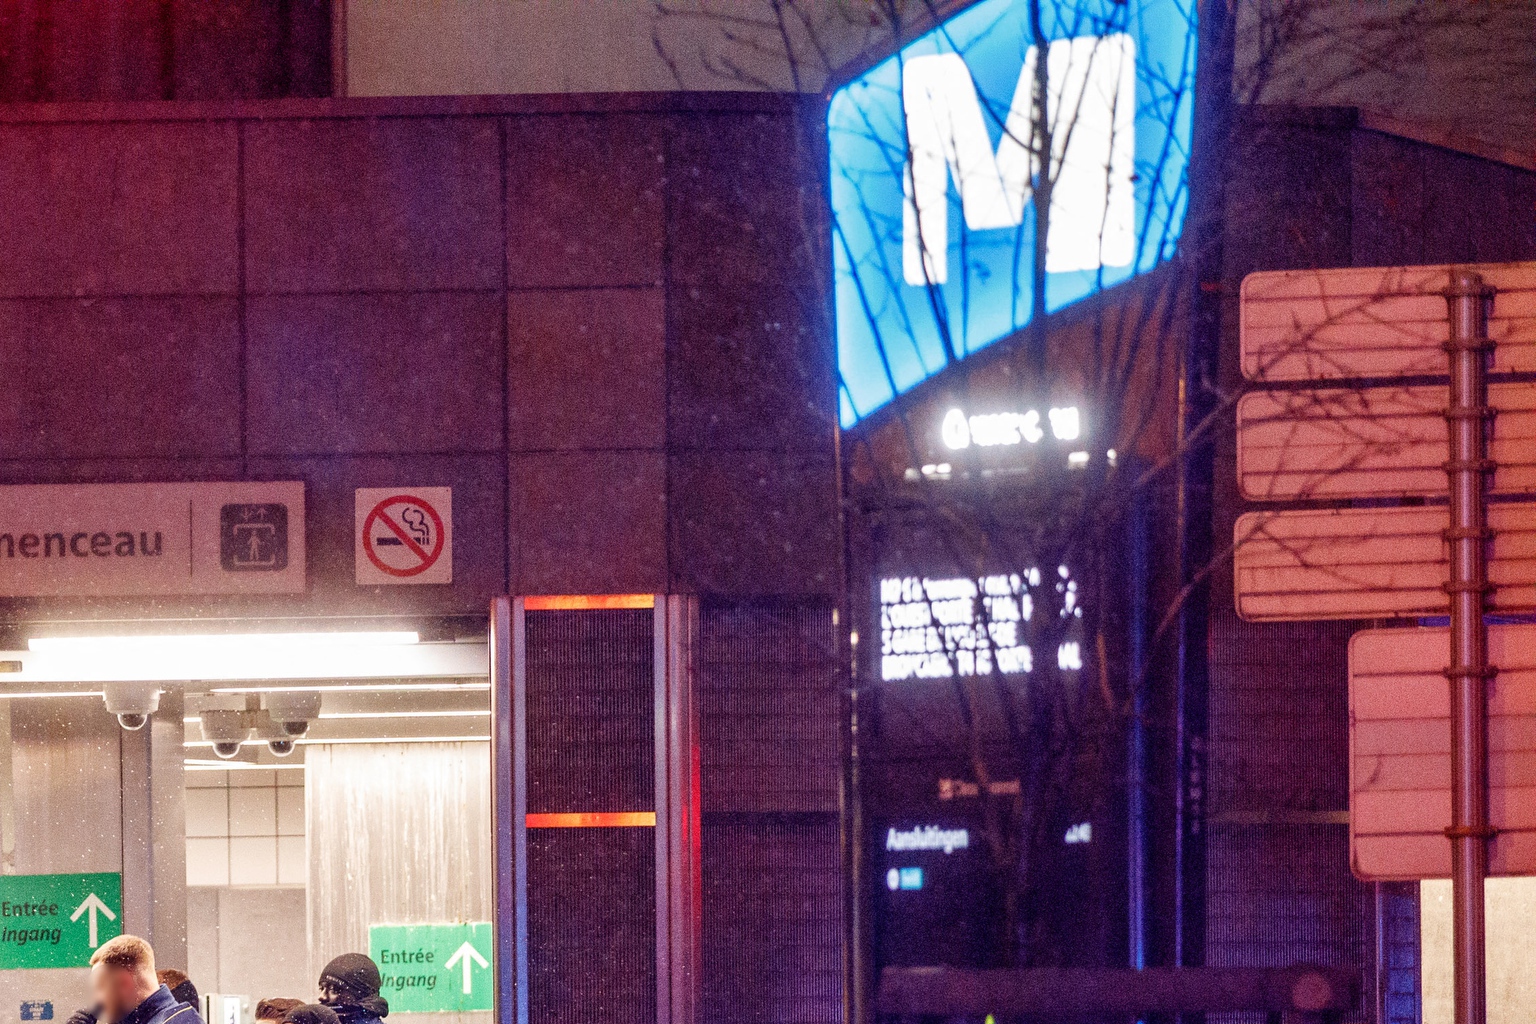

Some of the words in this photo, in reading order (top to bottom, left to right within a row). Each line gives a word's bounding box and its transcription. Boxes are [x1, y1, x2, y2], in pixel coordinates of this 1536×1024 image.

[902, 32, 1135, 286] M
[1, 900, 59, 917] Entrée
[380, 948, 435, 964] Entrée
